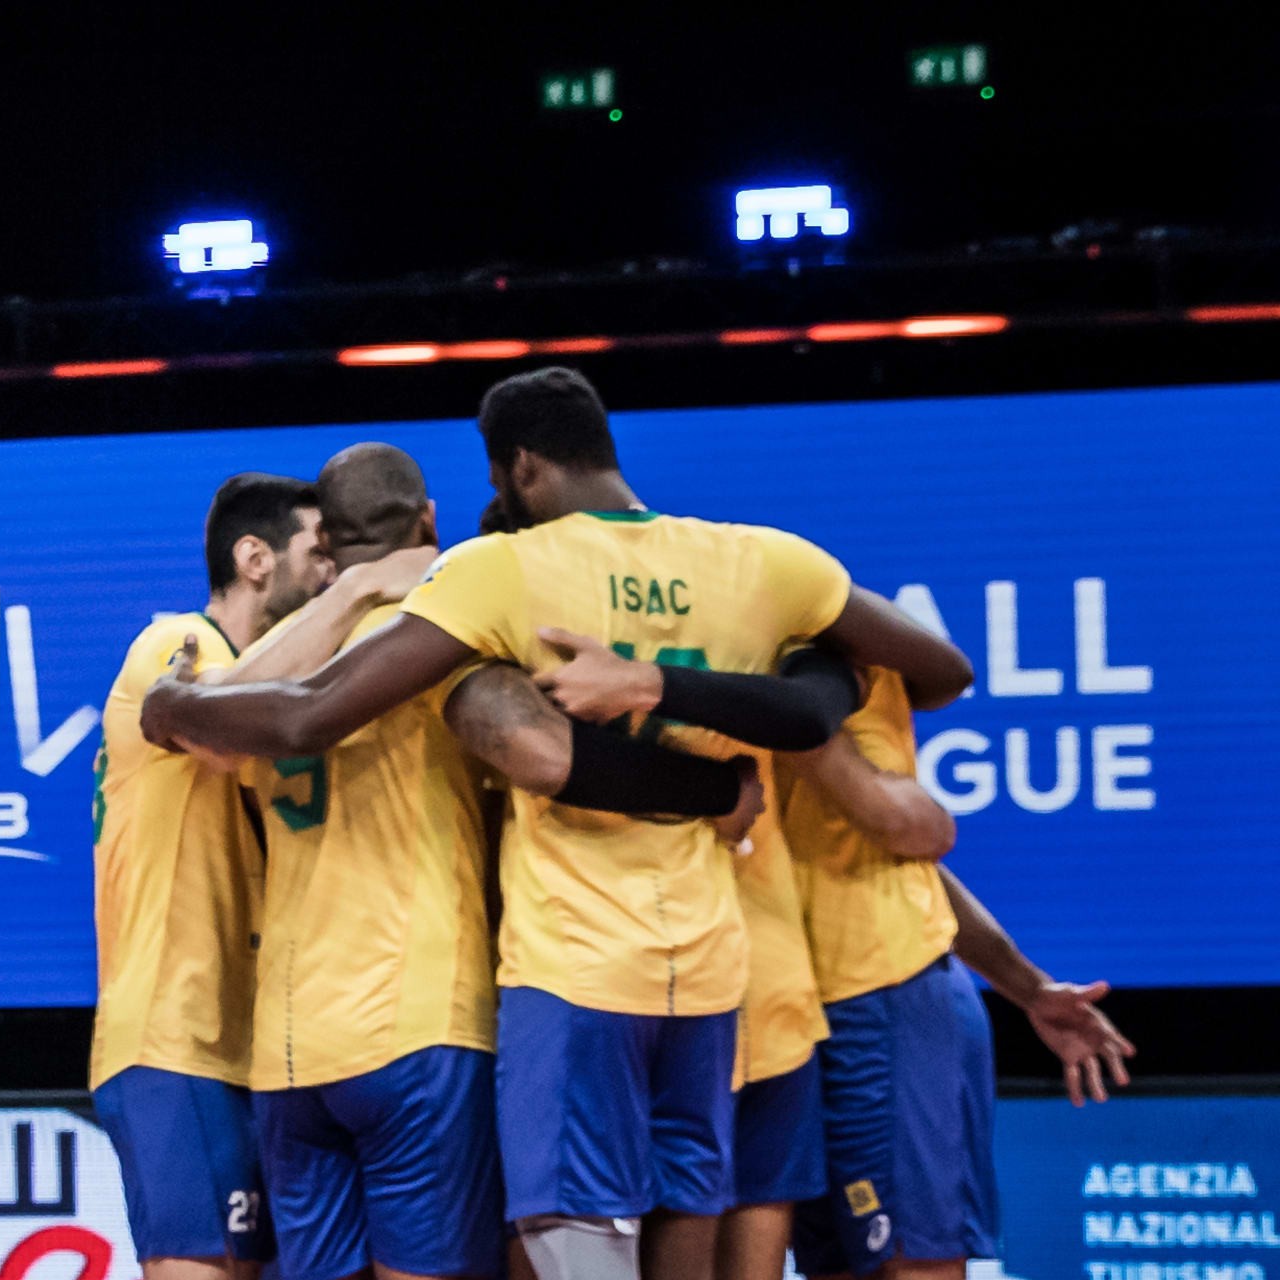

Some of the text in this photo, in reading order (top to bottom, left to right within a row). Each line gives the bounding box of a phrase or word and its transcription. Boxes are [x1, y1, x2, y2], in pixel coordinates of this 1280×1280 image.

[609, 575, 690, 615] ISAC
[915, 728, 1157, 816] GUE
[1083, 1163, 1258, 1197] AGENZIA
[1084, 1211, 1280, 1248] NAZIONAL
